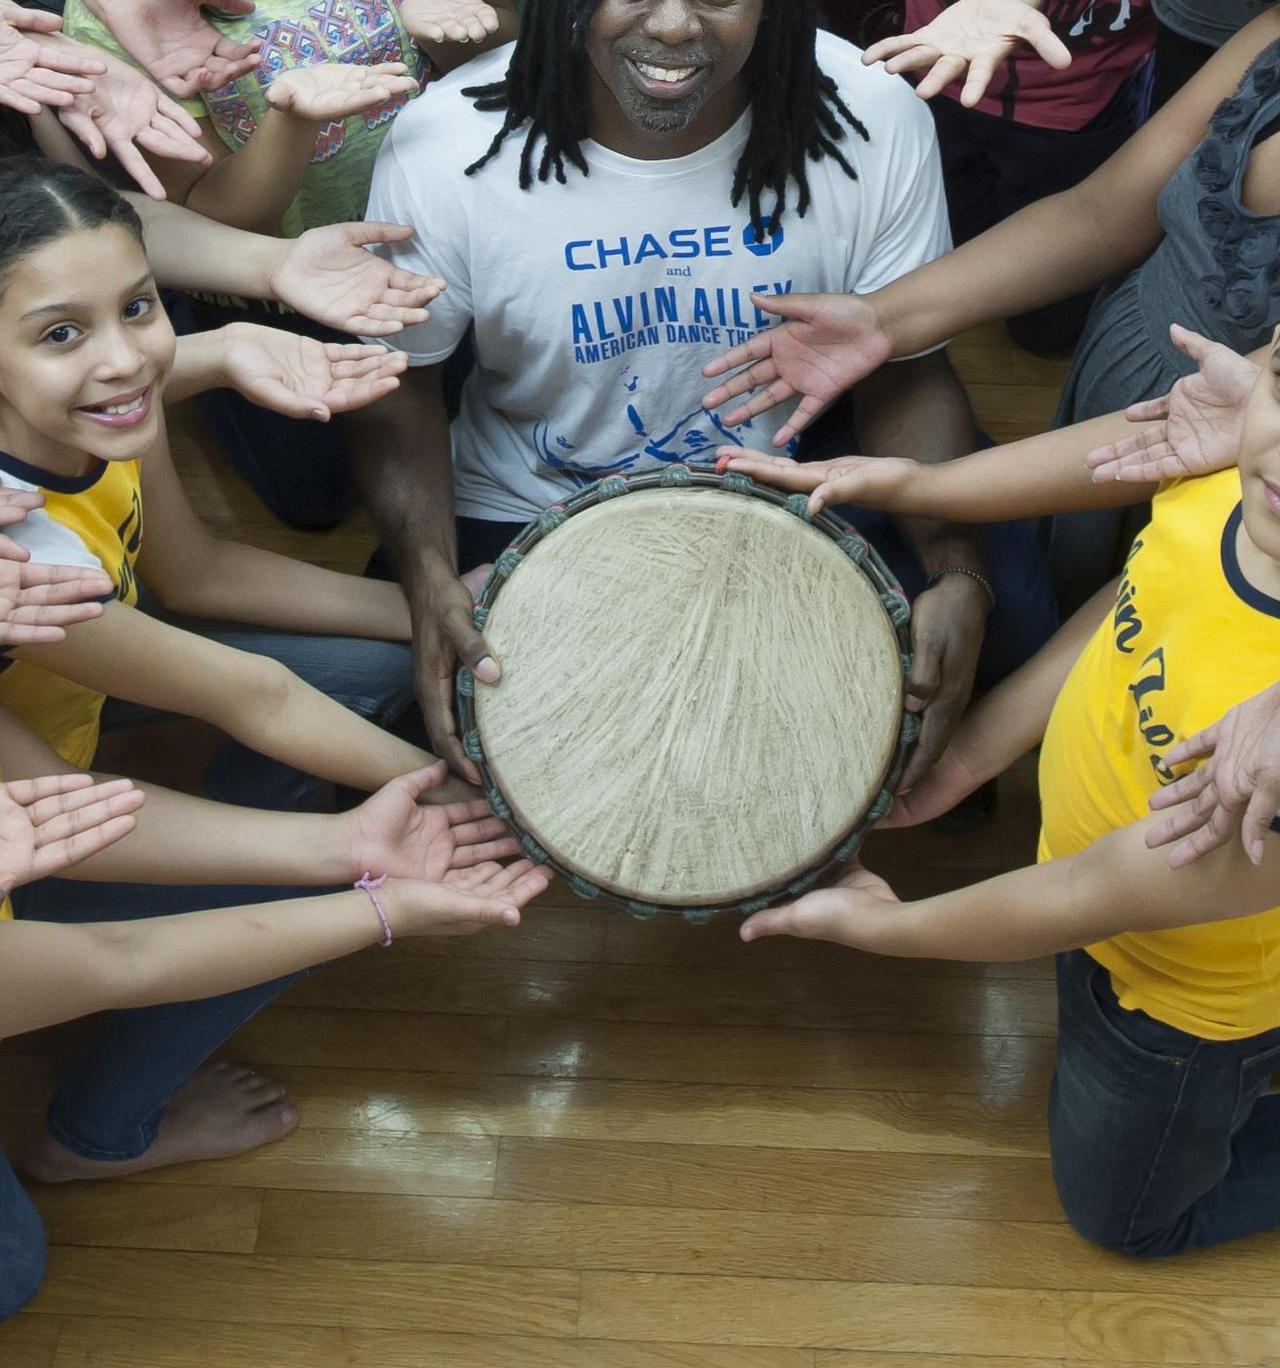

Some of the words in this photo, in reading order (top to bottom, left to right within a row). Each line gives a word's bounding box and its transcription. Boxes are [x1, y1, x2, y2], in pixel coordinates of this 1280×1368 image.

[564, 225, 733, 272] CHASE
[665, 265, 692, 278] and
[571, 285, 679, 345] ALVIN
[574, 324, 660, 364] AMERICAN
[666, 323, 722, 345] DANCE
